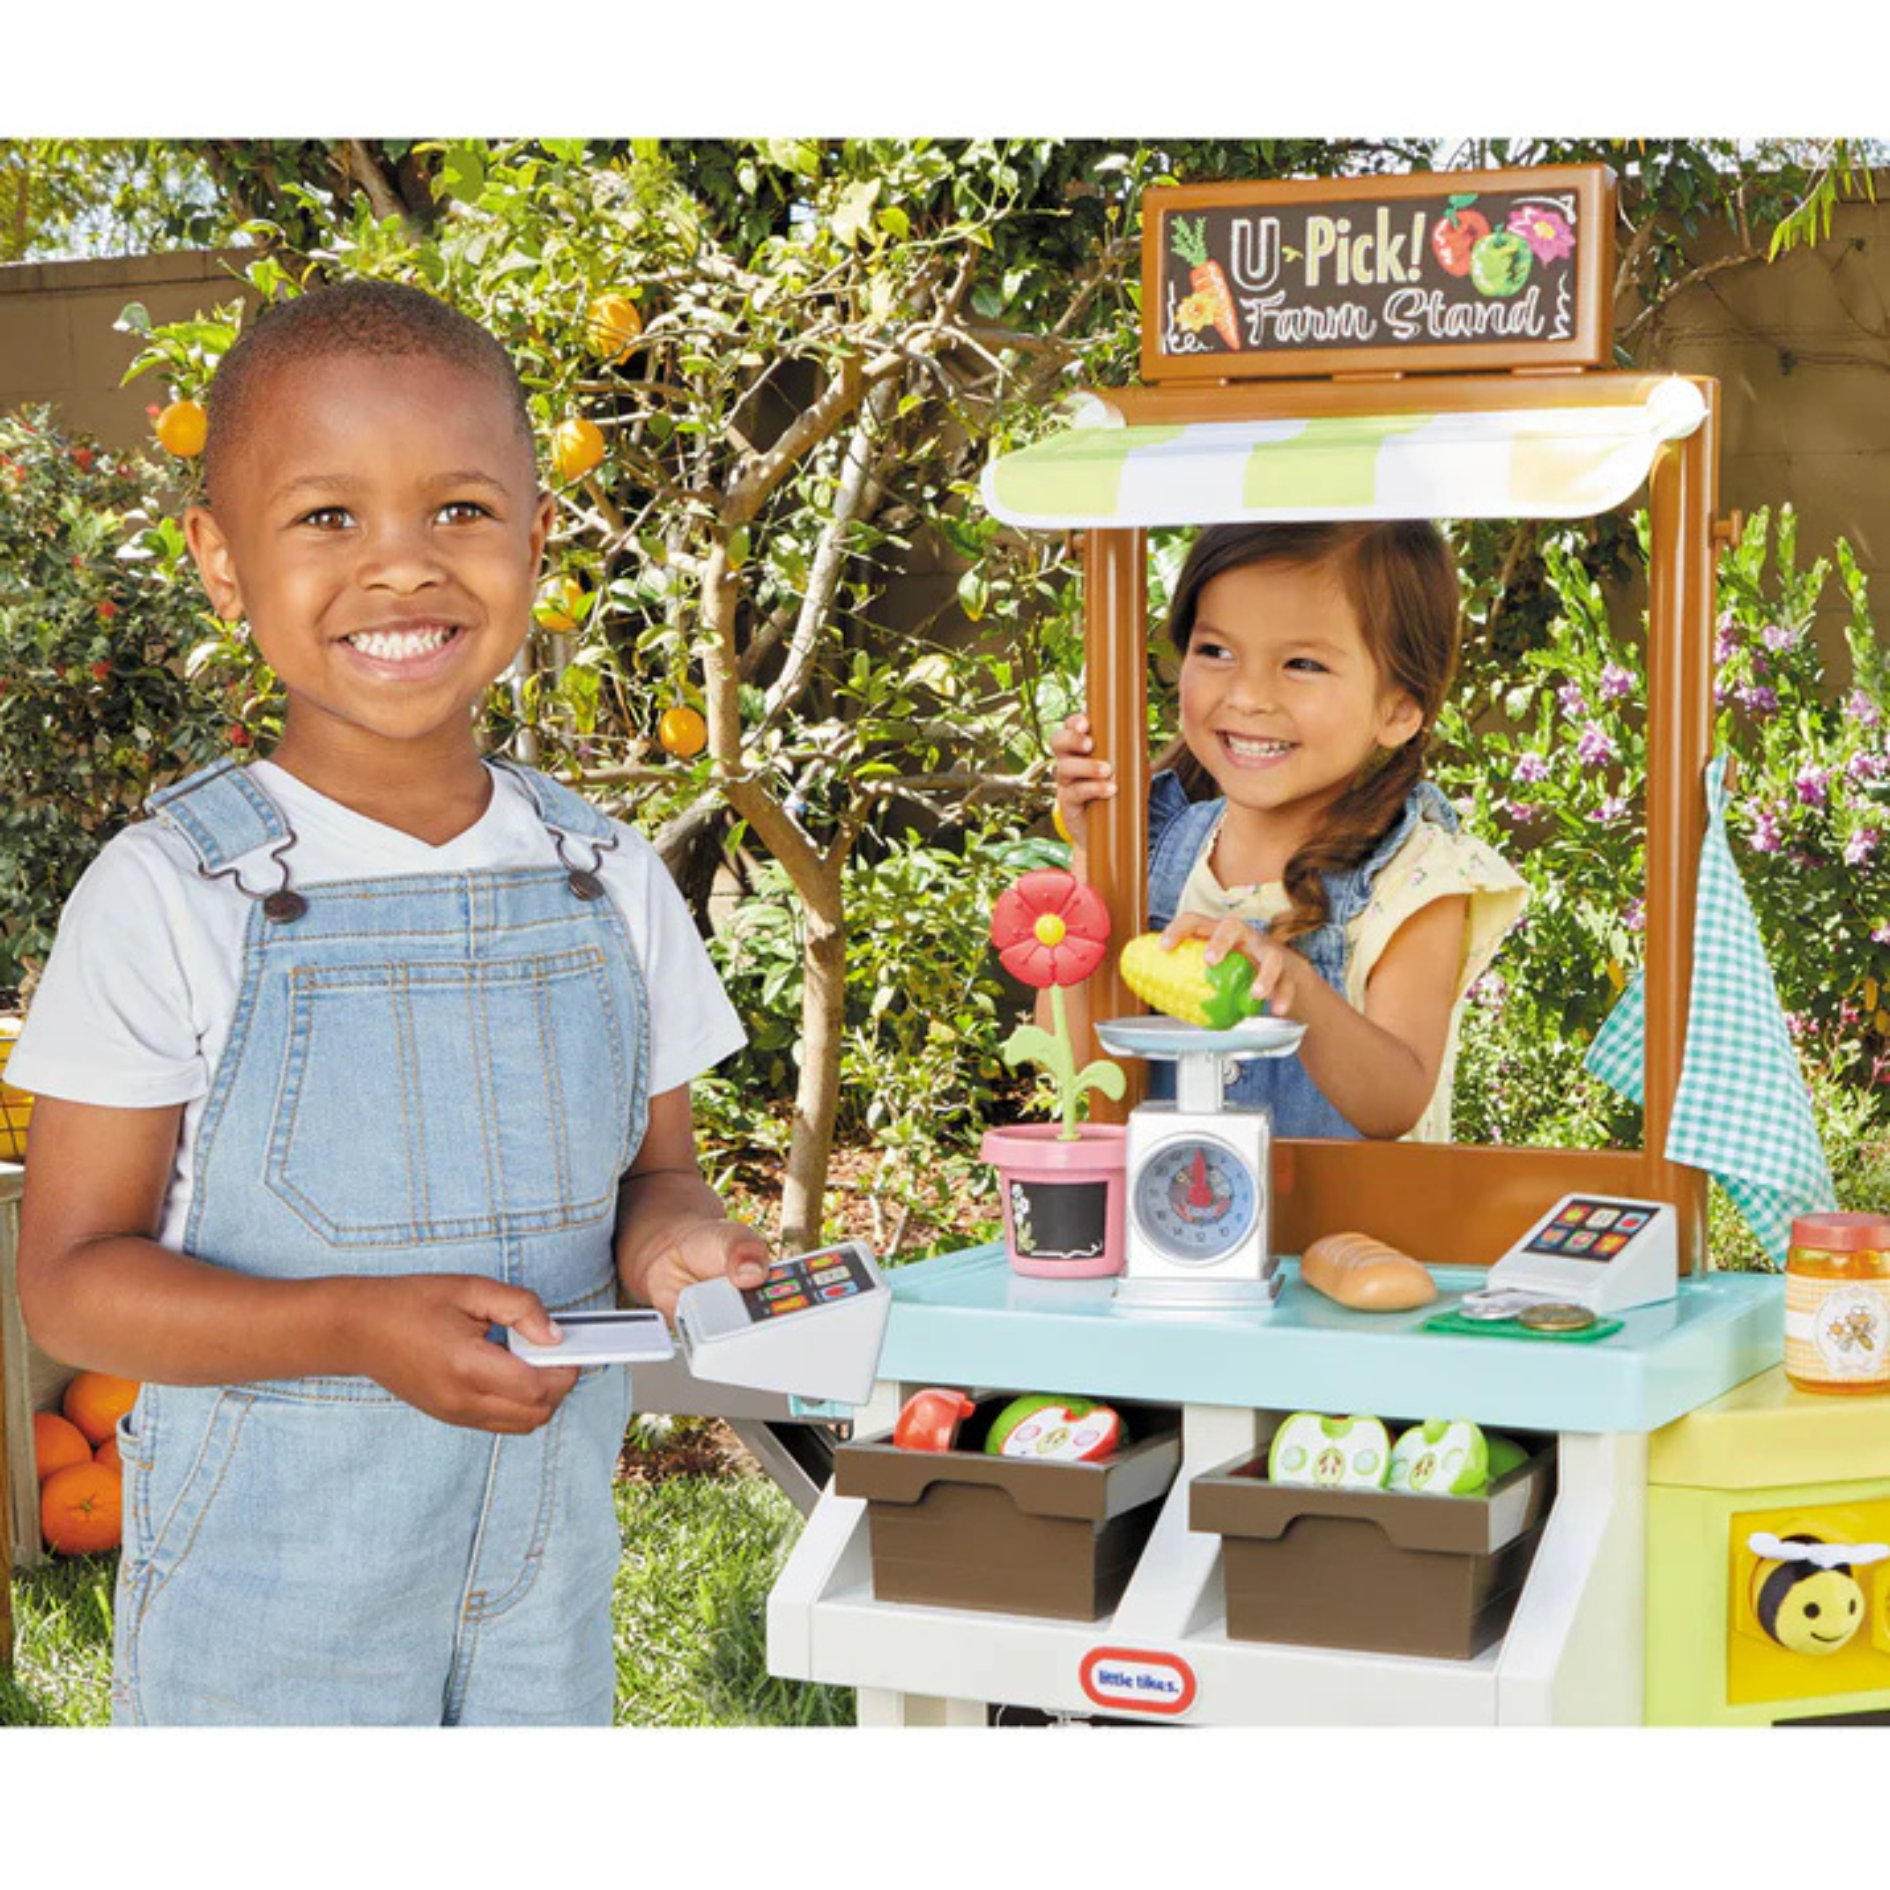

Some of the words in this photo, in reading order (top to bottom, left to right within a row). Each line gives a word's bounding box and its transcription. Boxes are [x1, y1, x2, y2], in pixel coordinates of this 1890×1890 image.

[1239, 291, 1377, 346] Farm
[1384, 286, 1544, 341] Stand
[1098, 1669, 1133, 1688] little
